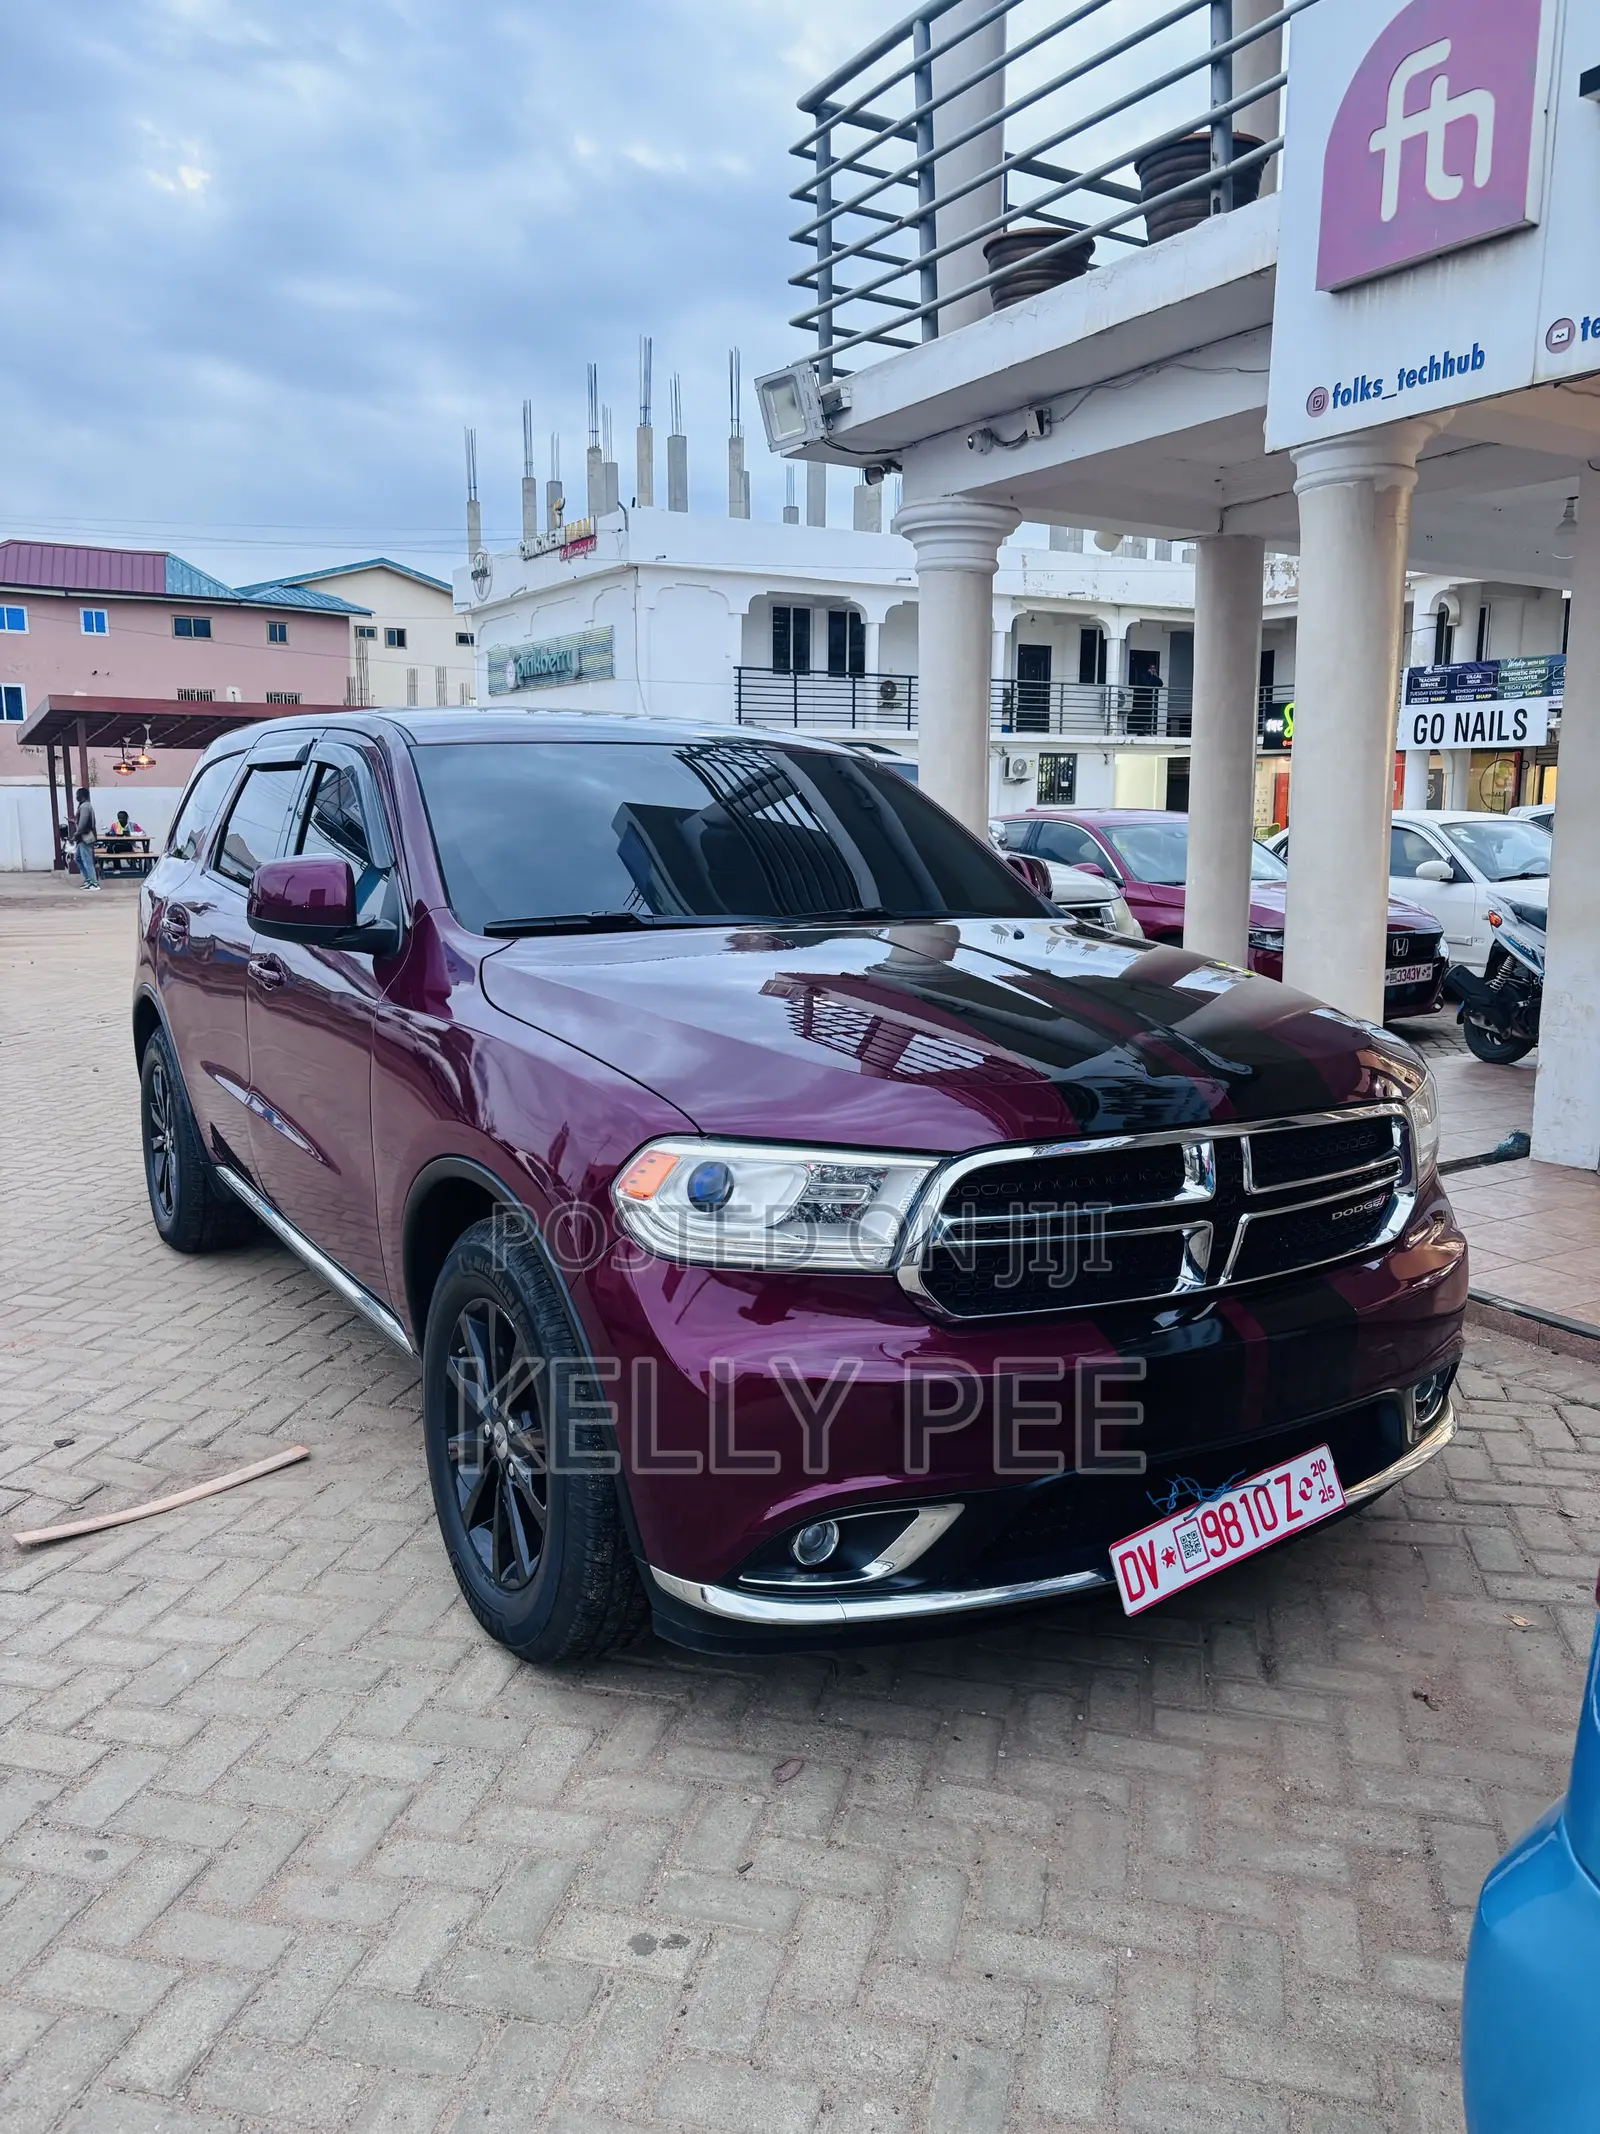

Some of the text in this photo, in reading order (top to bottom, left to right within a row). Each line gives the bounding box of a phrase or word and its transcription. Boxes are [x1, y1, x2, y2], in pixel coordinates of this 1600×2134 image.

[1332, 343, 1485, 409] folks_techhub
[517, 648, 574, 685] pinkberry
[1413, 708, 1528, 744] GO NAILS
[1331, 1201, 1381, 1220] DODGE
[1118, 1540, 1159, 1602] DV
